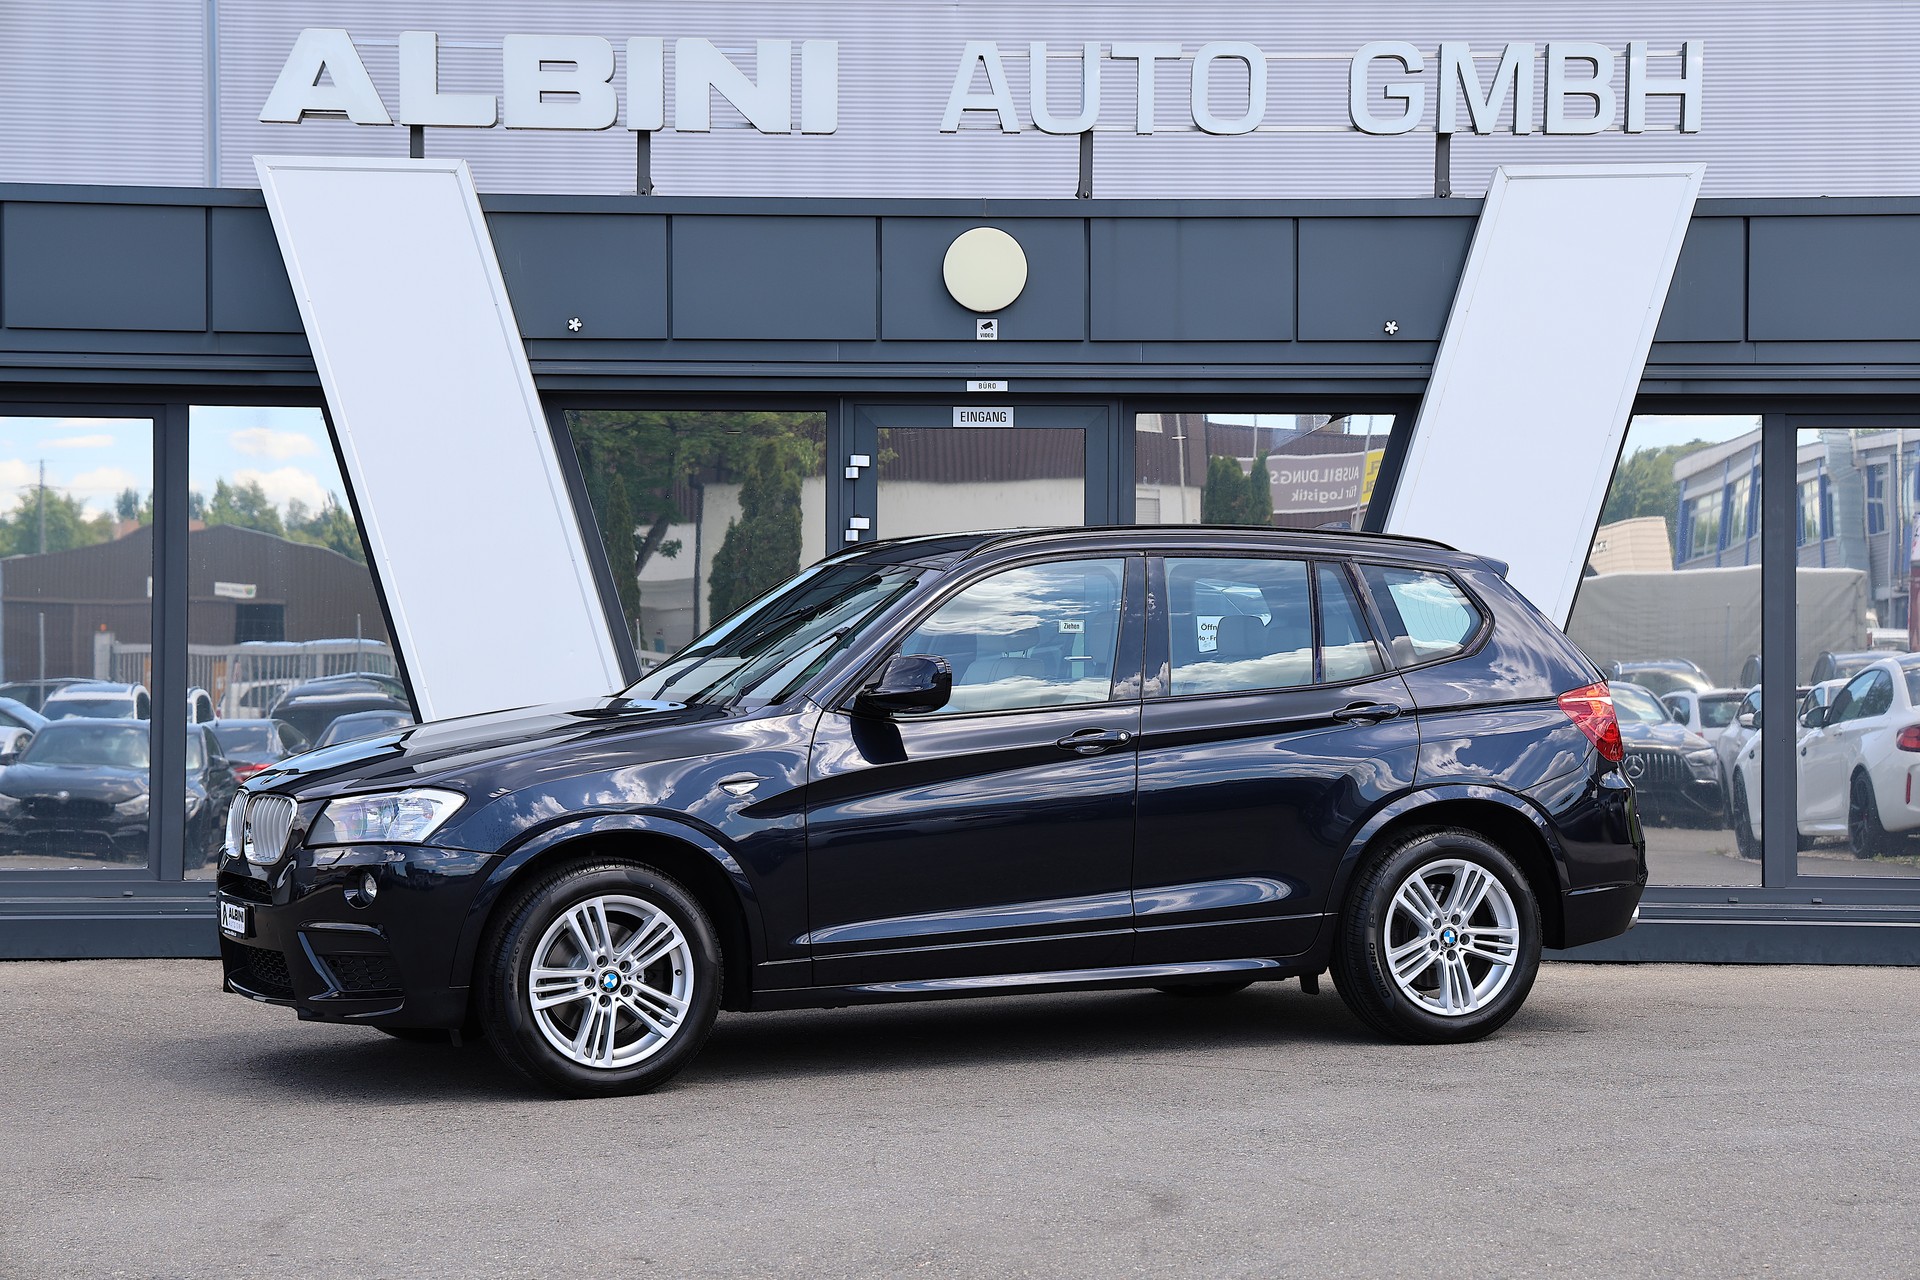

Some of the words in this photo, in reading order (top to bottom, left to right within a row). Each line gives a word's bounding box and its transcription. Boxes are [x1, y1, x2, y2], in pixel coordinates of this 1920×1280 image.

[258, 28, 839, 135] ALBINI
[940, 41, 1267, 135] AUTO
[1350, 41, 1704, 135] GMBH
[960, 411, 1007, 423] EINGANG
